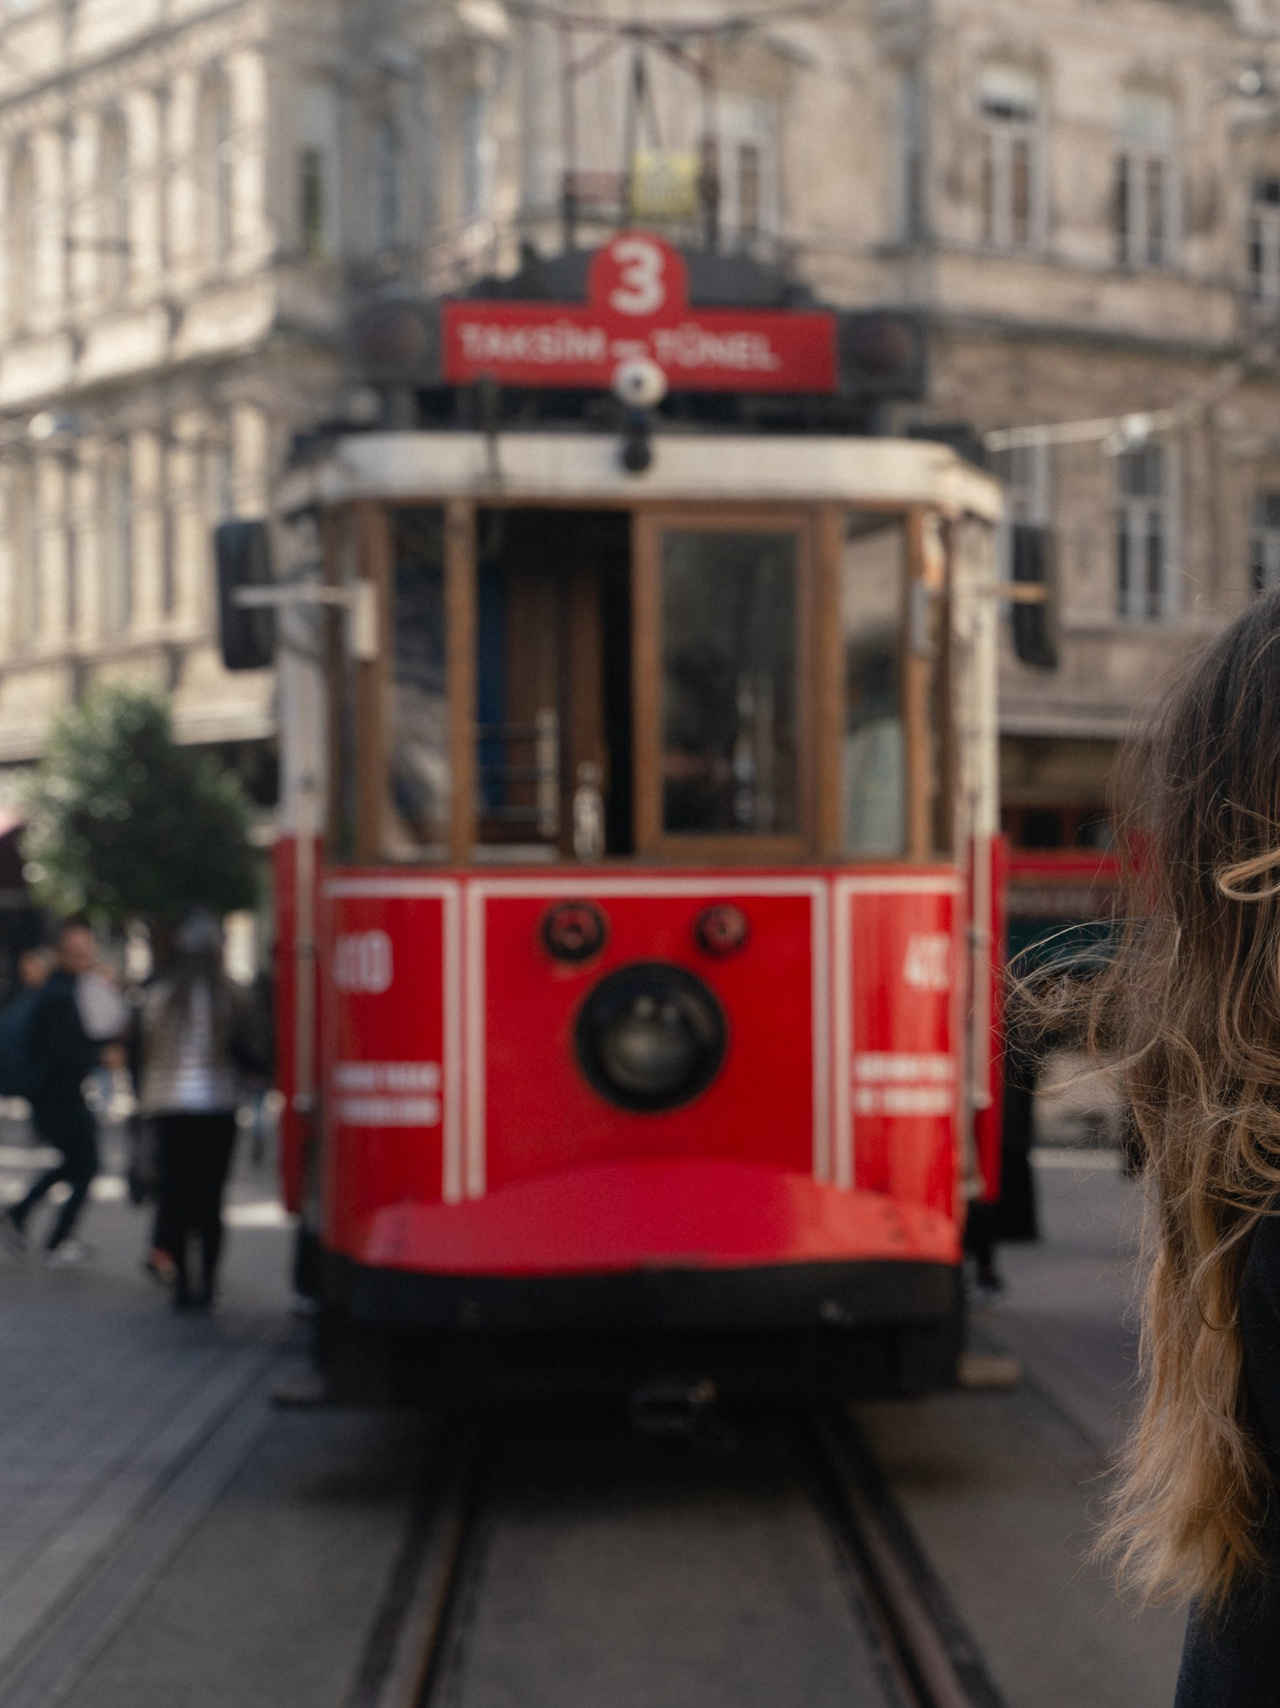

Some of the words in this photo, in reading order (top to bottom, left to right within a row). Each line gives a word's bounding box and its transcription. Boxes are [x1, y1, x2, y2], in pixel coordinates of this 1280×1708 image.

[609, 240, 666, 316] 3
[458, 317, 606, 364] TAKSİM
[651, 320, 782, 372] TÜNEL
